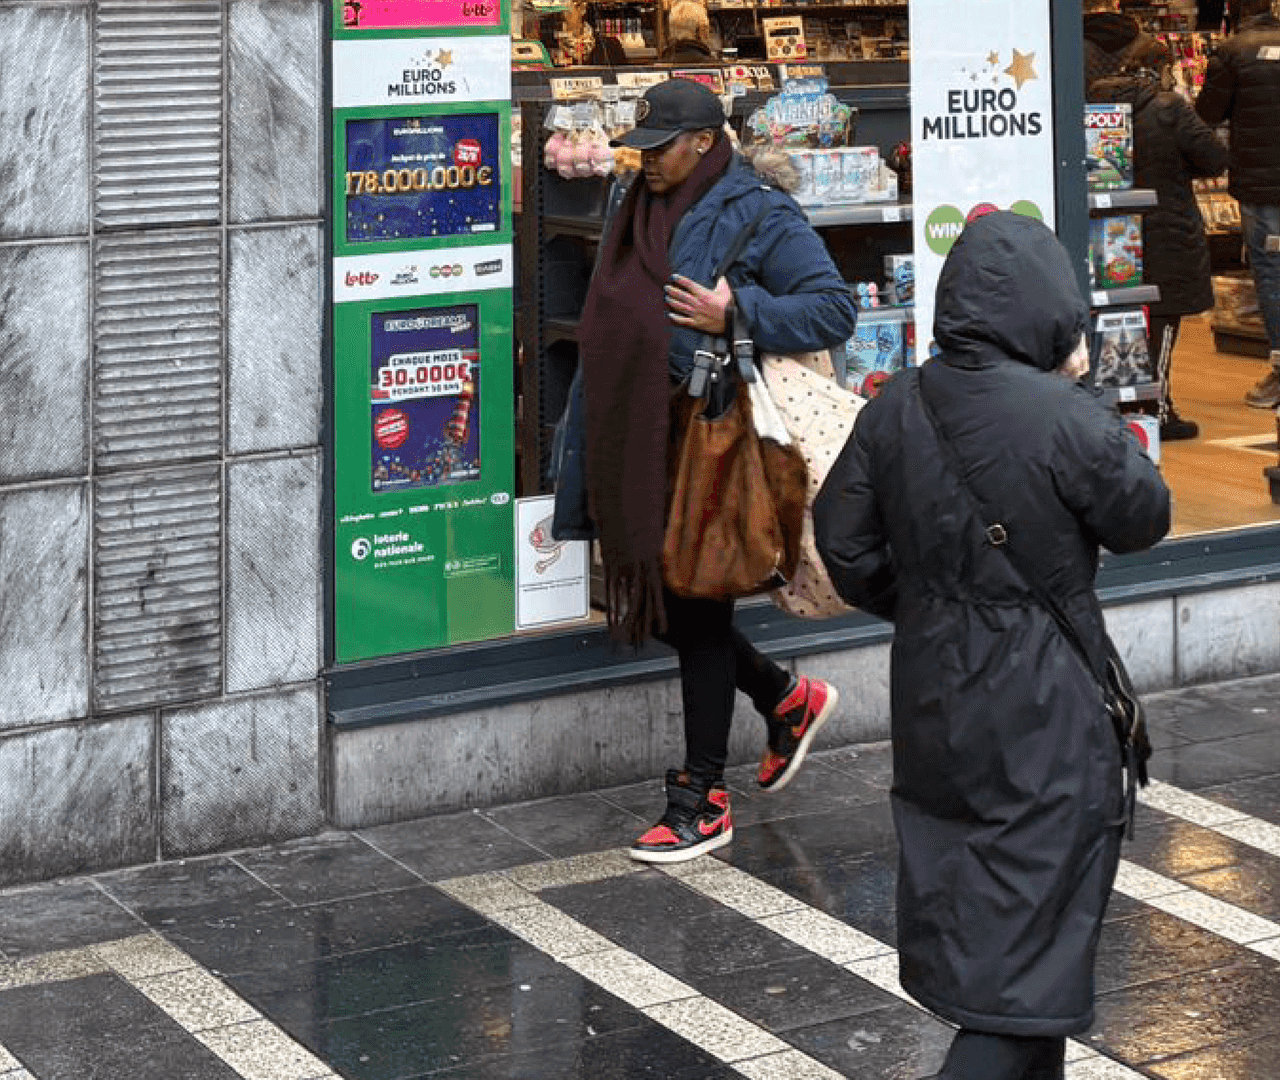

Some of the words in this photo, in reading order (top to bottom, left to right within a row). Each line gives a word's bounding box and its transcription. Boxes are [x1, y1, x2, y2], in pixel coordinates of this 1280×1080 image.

[402, 68, 442, 83] EURO
[387, 80, 457, 97] MILLIONS
[947, 87, 1017, 114] EURO
[922, 112, 1043, 141] MILLIONS
[373, 541, 424, 559] nationale
